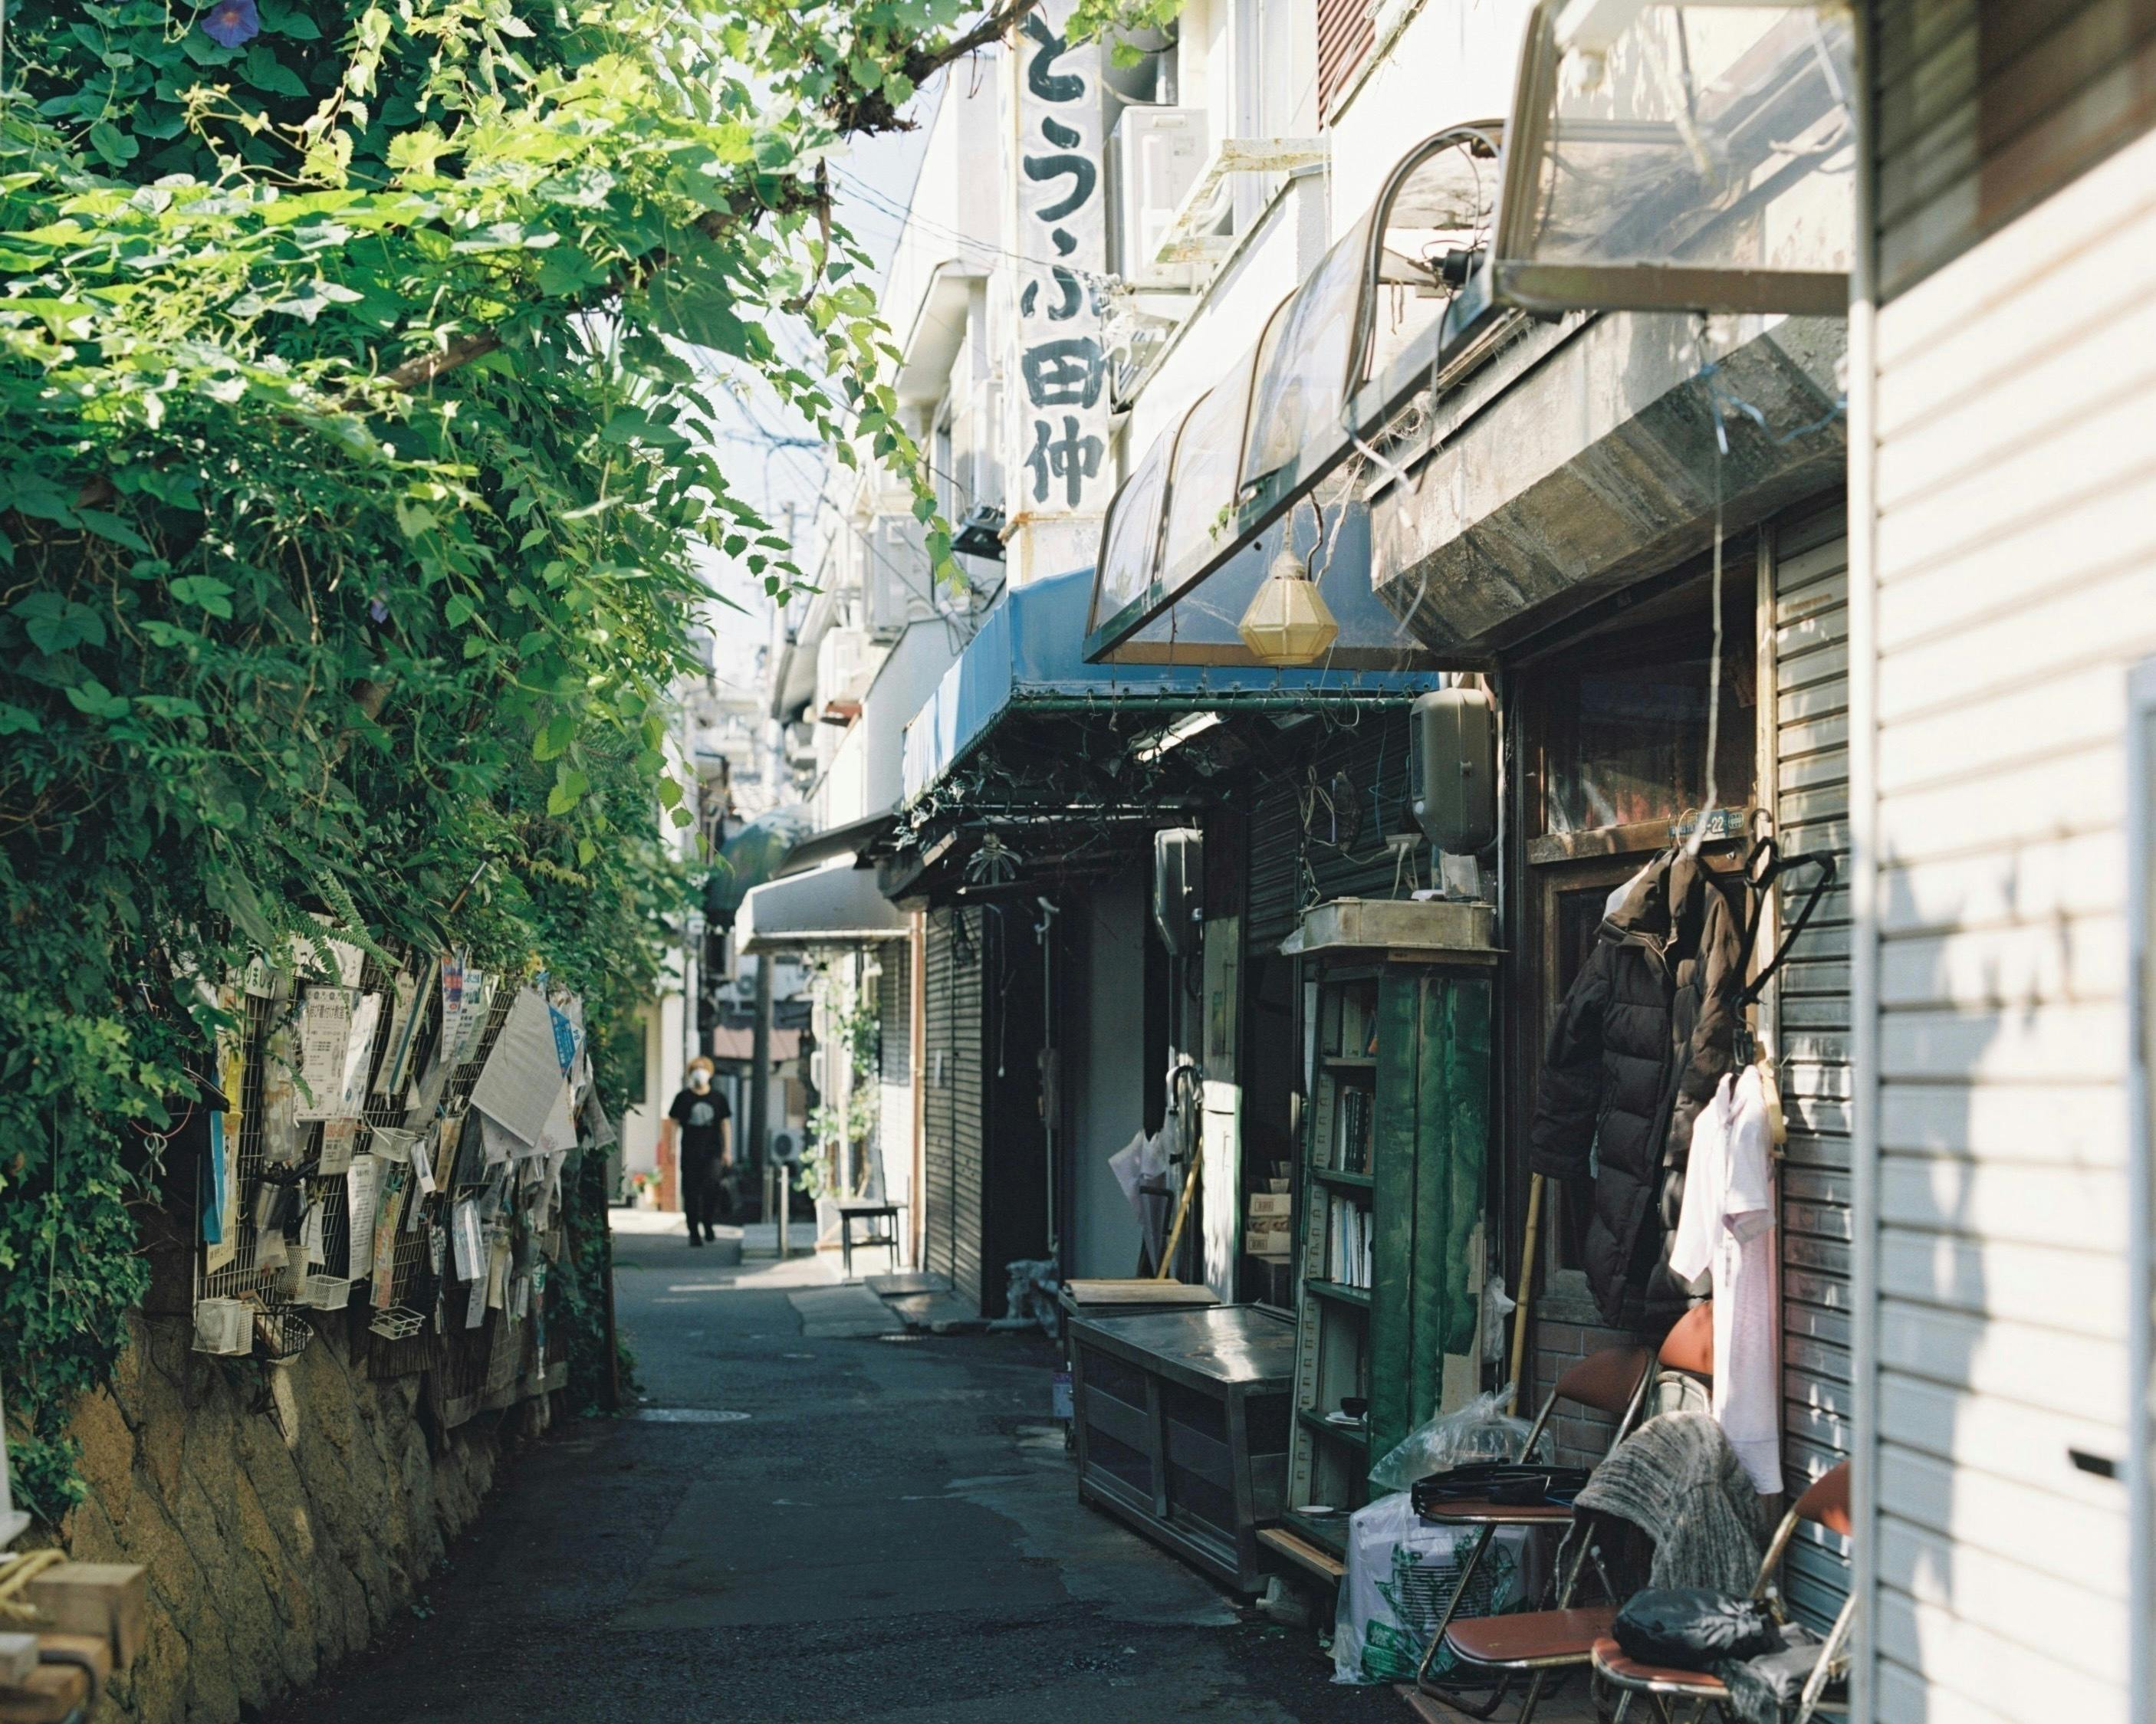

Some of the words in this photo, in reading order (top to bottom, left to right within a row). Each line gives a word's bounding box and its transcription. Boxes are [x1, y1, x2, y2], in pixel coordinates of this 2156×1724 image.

[1021, 10, 1105, 508] とうふ田仲
